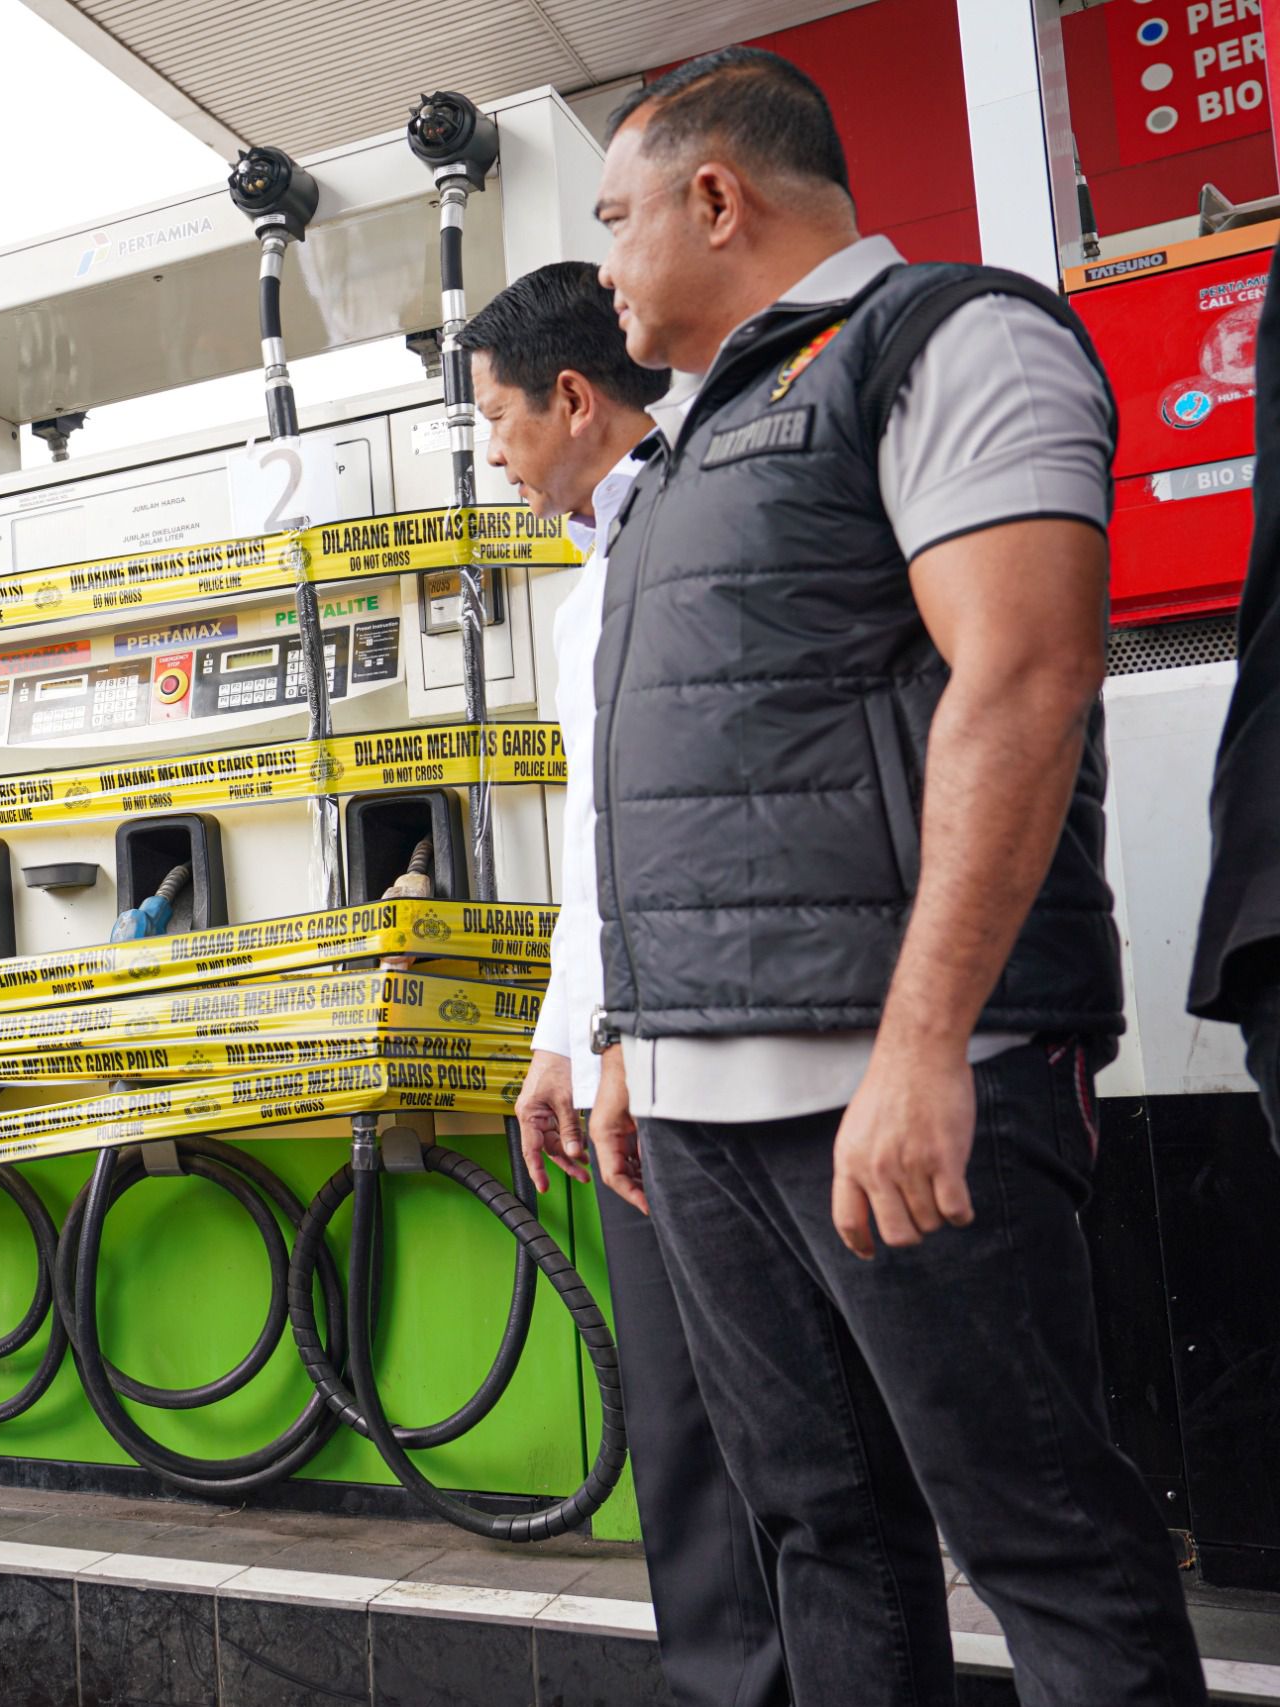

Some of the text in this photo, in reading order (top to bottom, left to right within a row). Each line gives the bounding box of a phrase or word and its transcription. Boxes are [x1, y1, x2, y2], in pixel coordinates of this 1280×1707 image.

[1198, 80, 1263, 123] BIO
[118, 217, 214, 256] PERTAMINA
[1088, 253, 1163, 281] TATSUNO
[1200, 288, 1267, 311] CALL CEN
[1198, 468, 1234, 489] BIO
[259, 449, 308, 532] 2
[132, 497, 186, 513] JUMLAH HARGA
[123, 522, 200, 543] JUMLAH DIKELUARKAN
[139, 533, 184, 547] DALAM LITER
[322, 525, 389, 555] DILARANG
[393, 514, 464, 545] MELINTAS
[468, 512, 510, 540] GARIS
[350, 551, 410, 572] DO NOT CROSS
[480, 543, 532, 559] POLICE LINE
[70, 540, 265, 593] DILARANG MELINTAS GARIS POLISI
[198, 574, 242, 593] POLICE LINE
[93, 588, 142, 609] DO NOT CROSS
[275, 596, 379, 627] PEALITE
[127, 622, 222, 650] PERTAMAX
[355, 736, 423, 767] DILARANG
[427, 729, 498, 760] MELINTAS
[502, 729, 546, 757] GARIS
[99, 749, 297, 792] DILARANG MELINTAS GARIS POLISI
[383, 764, 444, 784] DO NOT CROSS
[514, 760, 567, 776] POLICE LINE
[19, 777, 55, 802] POLISI
[229, 781, 273, 800] POLICE LINE
[123, 792, 173, 811] DO NOT CROSS
[18, 807, 34, 822] LINE
[171, 905, 397, 960] DILARANG MELINTAS GARIS POLISI
[463, 908, 534, 937] DILARANG
[317, 935, 367, 957] POLICE LINE
[492, 939, 523, 956] DO NOT
[196, 955, 254, 975] DO NOT CROSS
[171, 977, 424, 1023] DILARANG MELINTAS GARIS POLISI
[331, 1007, 388, 1026] POLICE LINE
[196, 1020, 259, 1036] DO NOT CROSS
[225, 1037, 471, 1064] DILARANG MELINTAS GARIS POLISI
[21, 1055, 83, 1075] MELINTAS
[86, 1052, 124, 1073] GARIS
[127, 1049, 169, 1069] POLISI
[232, 1063, 486, 1103] DILARANG MELINTAS GARIS POLISI
[261, 1098, 325, 1118] DO NOT CROSS
[400, 1092, 455, 1107] POLICE LINE
